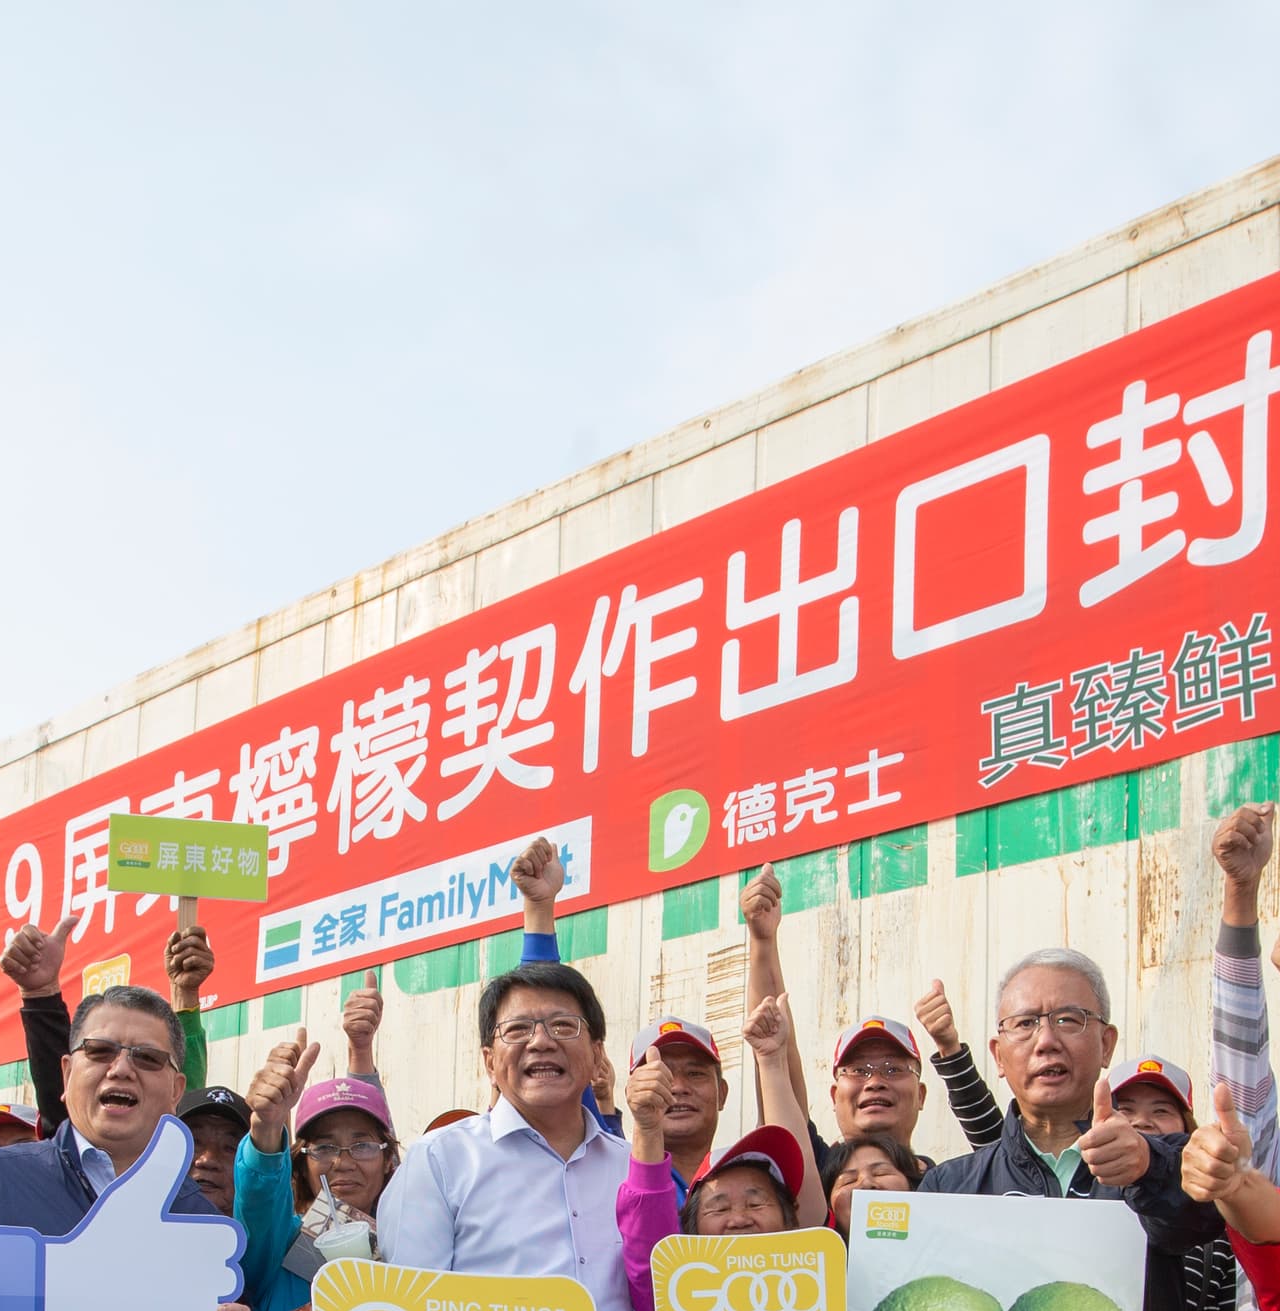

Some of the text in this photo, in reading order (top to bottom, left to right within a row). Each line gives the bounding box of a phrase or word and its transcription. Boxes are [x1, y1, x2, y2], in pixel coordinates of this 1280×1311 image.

[979, 612, 1276, 789] 真臻鲜
[722, 749, 904, 849] 德克士
[157, 842, 260, 877] 屏東好物
[312, 843, 573, 955] 全家 FamilyMt
[726, 1252, 817, 1270] PING TUNG
